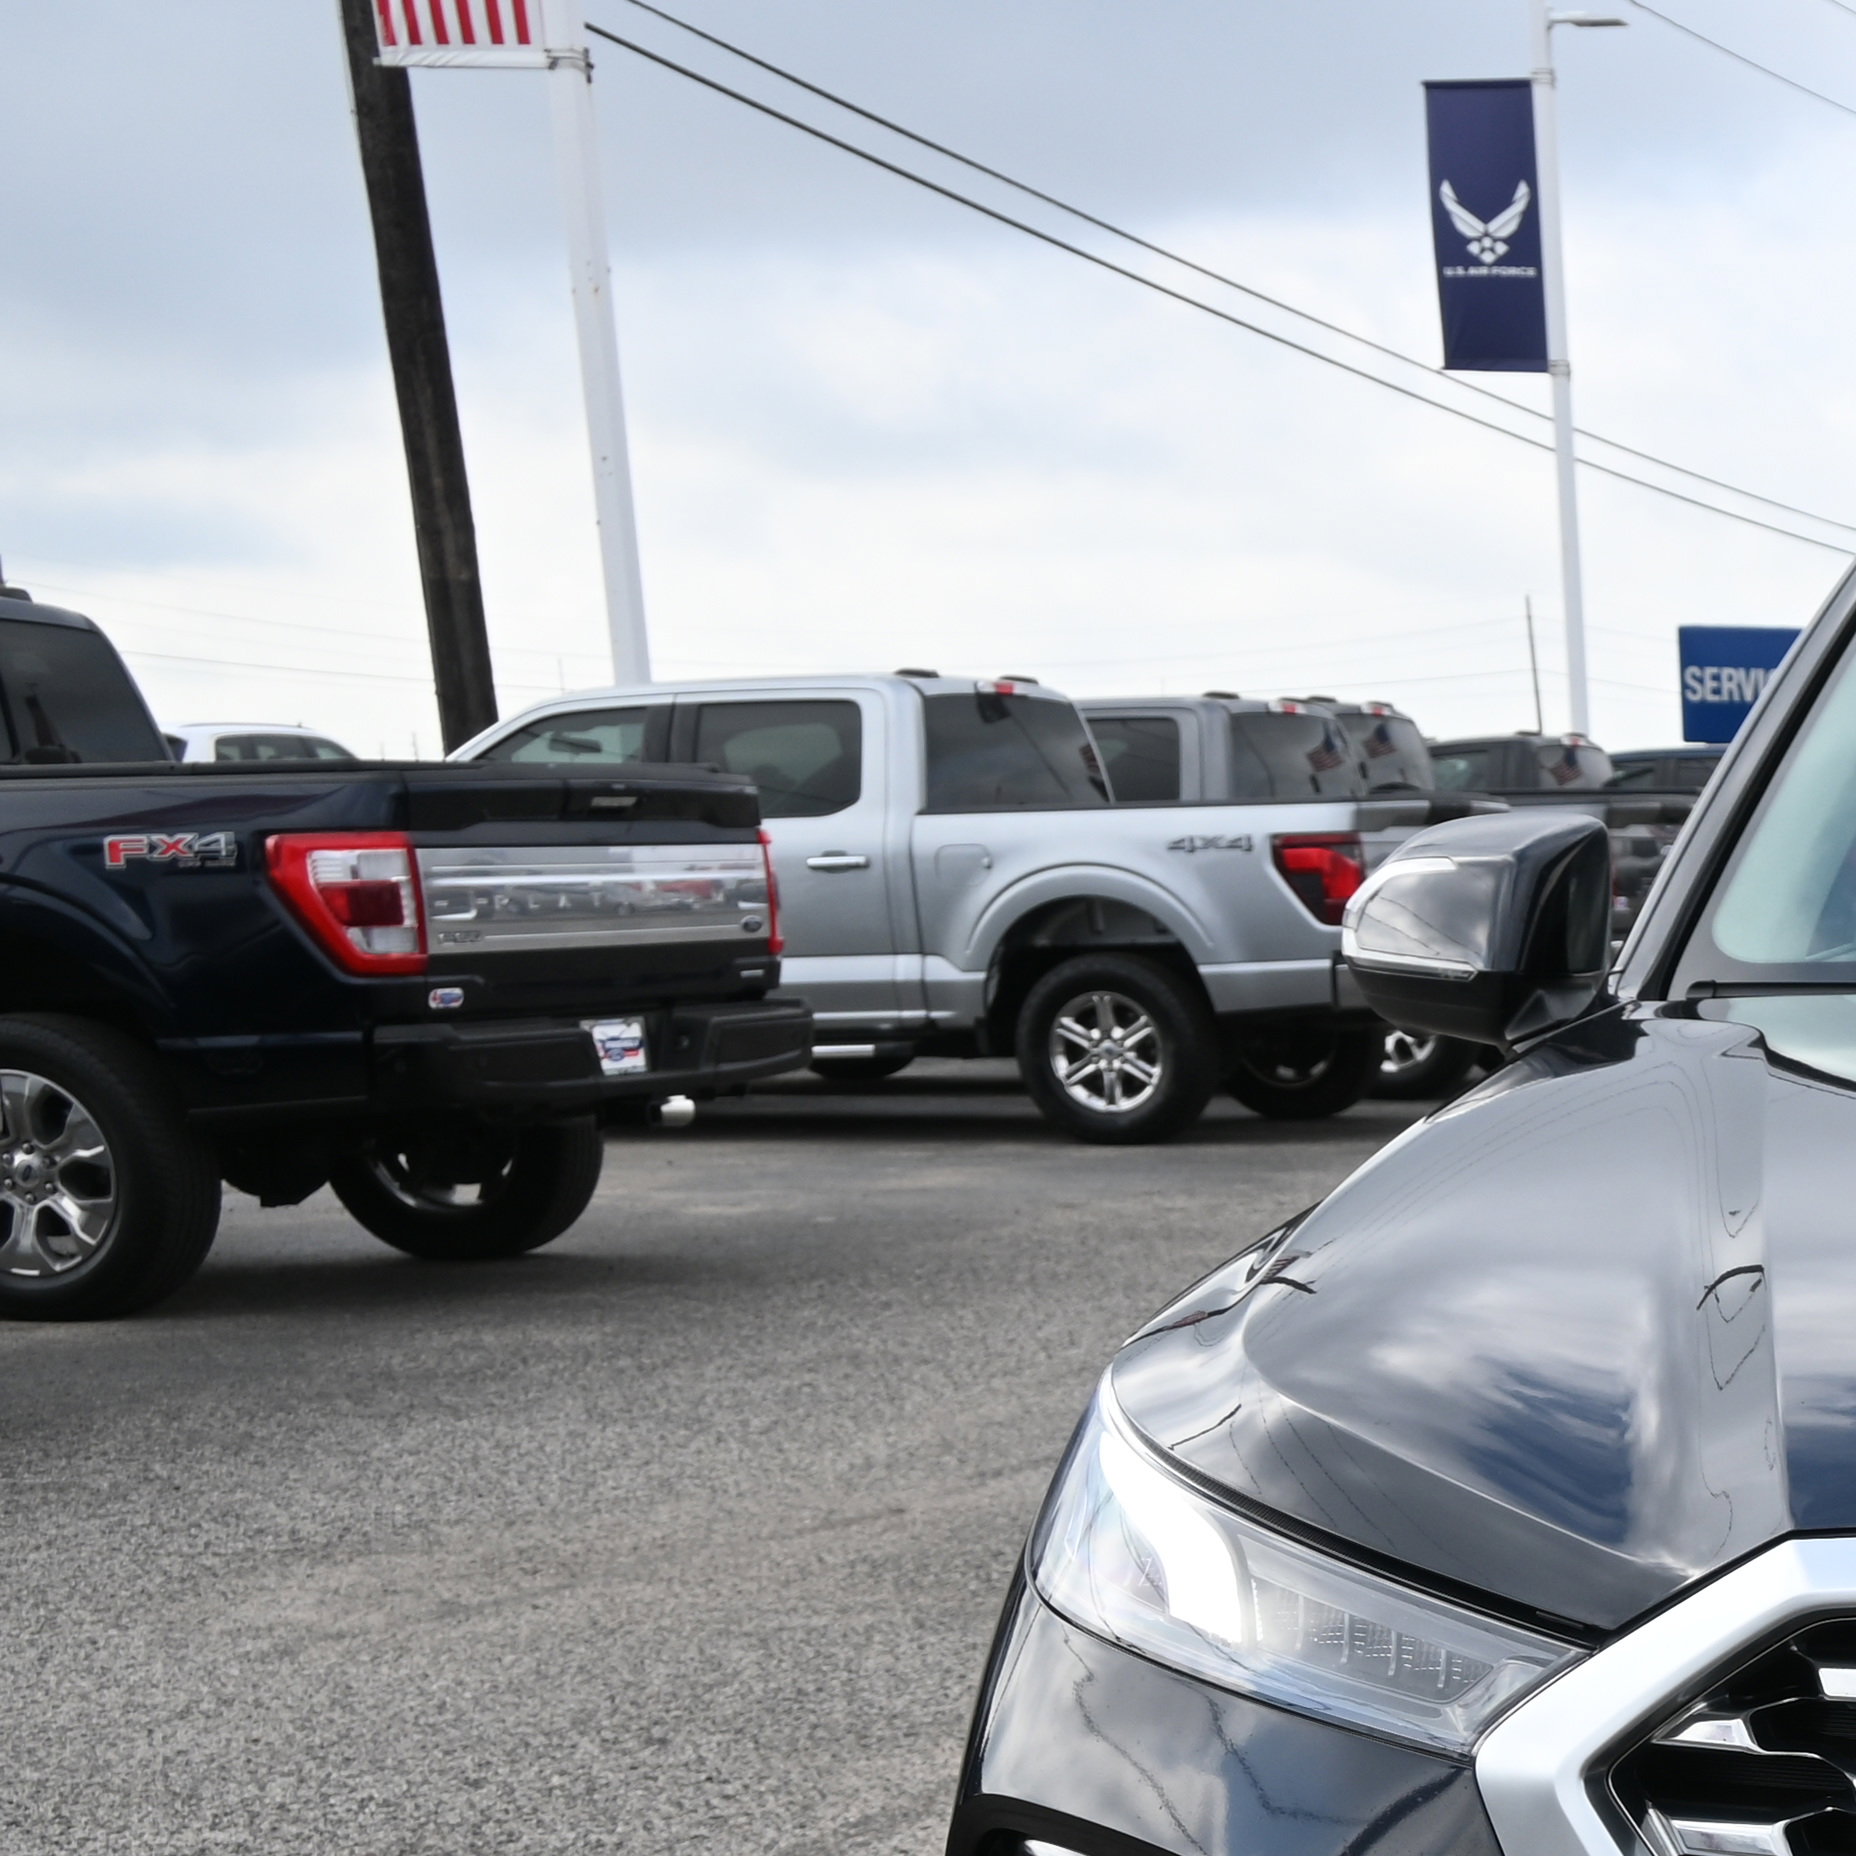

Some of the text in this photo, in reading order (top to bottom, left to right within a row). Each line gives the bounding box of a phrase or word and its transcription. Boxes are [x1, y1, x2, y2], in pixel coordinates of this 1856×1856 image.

[1467, 265, 1489, 278] AIR
[1491, 265, 1537, 278] FORCE
[1684, 665, 1776, 703] SERVI
[103, 831, 237, 869] FX4
